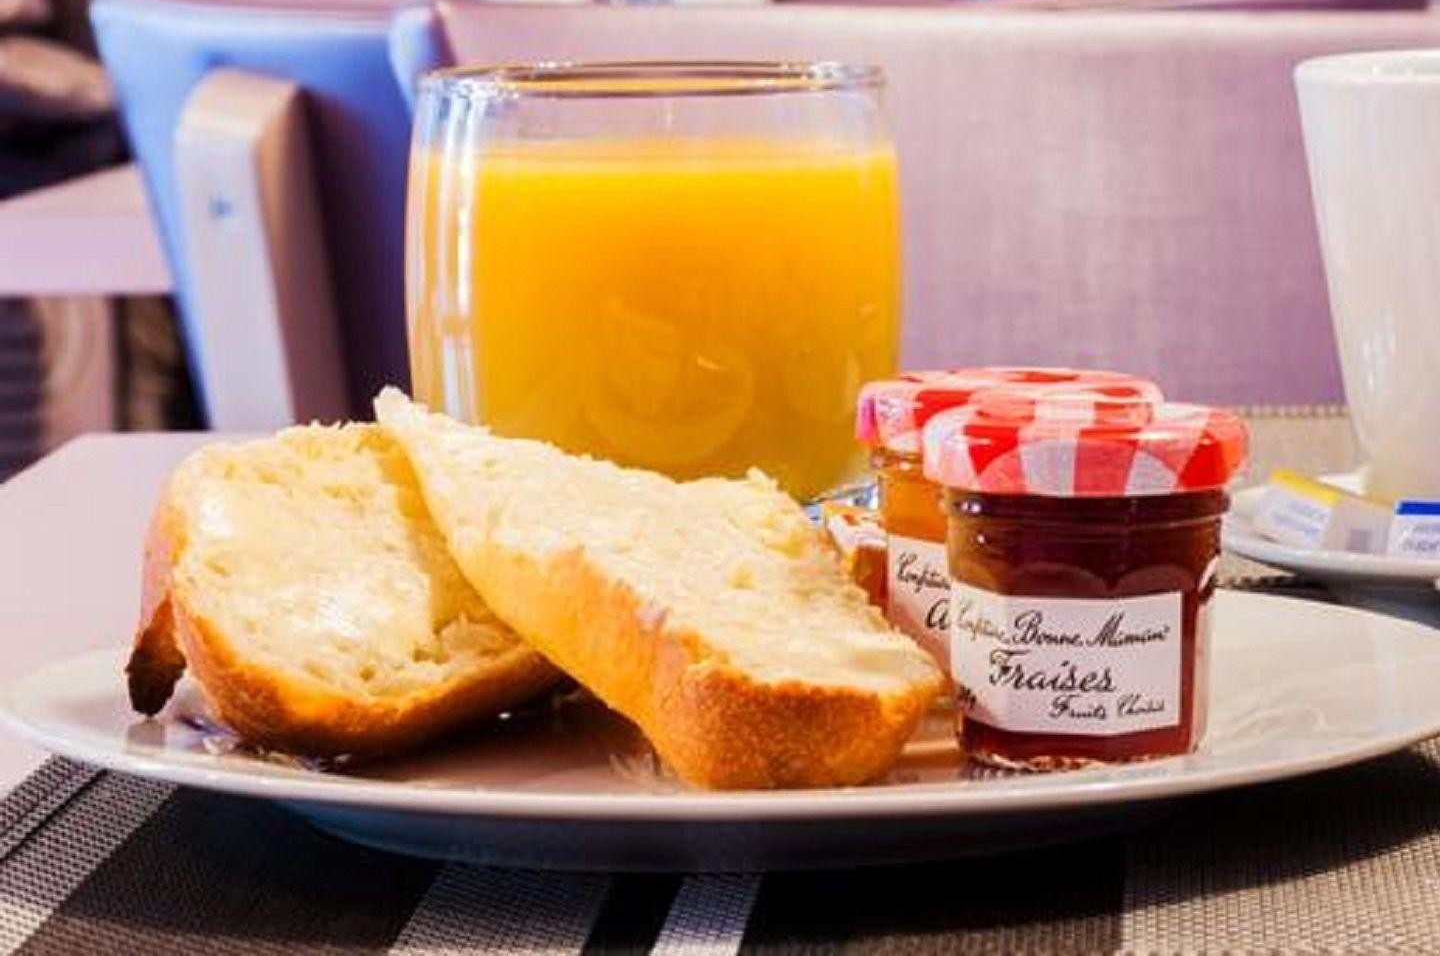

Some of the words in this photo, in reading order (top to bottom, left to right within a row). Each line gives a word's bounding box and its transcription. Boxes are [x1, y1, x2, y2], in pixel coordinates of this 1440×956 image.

[1012, 609, 1083, 646] Bonne
[1084, 611, 1166, 648] Maman
[989, 649, 1116, 693] Fraises
[1048, 694, 1106, 720] Fruits
